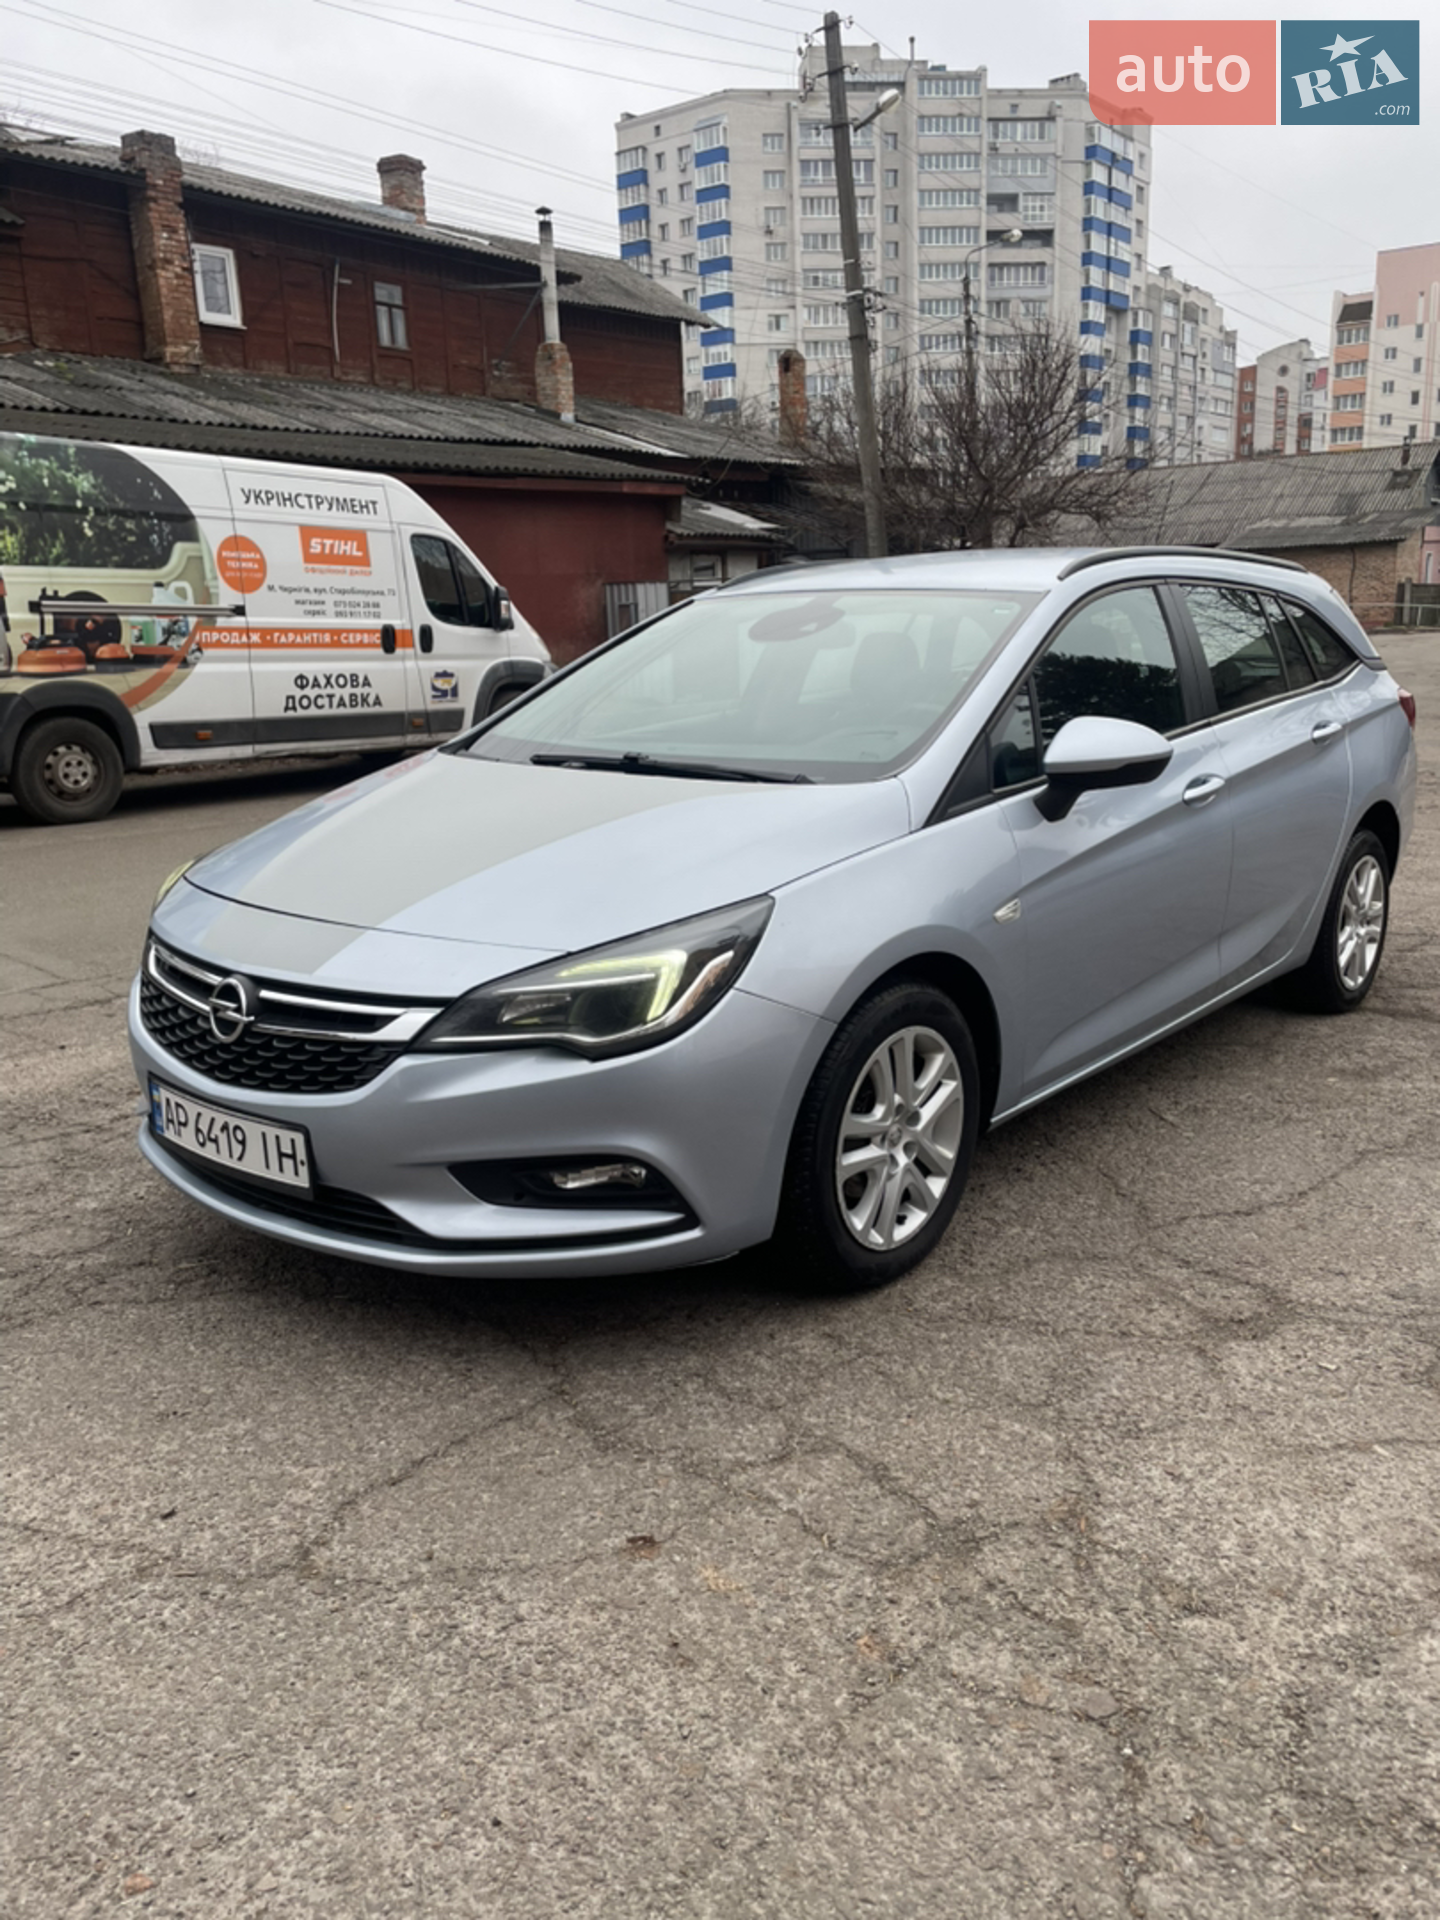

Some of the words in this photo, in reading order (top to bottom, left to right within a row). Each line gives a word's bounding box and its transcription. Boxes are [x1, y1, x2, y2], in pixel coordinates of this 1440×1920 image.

[240, 487, 379, 516] УКРІНСТРУМЕНТ
[308, 537, 364, 557] STIHL
[202, 631, 262, 644] ПРОДАЖ
[273, 632, 331, 644] ГАРАНТІЯ
[340, 632, 382, 644] СЕРВІС
[294, 673, 372, 691] ФАХОВА
[283, 693, 383, 713] ДОСТАВКА
[194, 1111, 247, 1162] 6419
